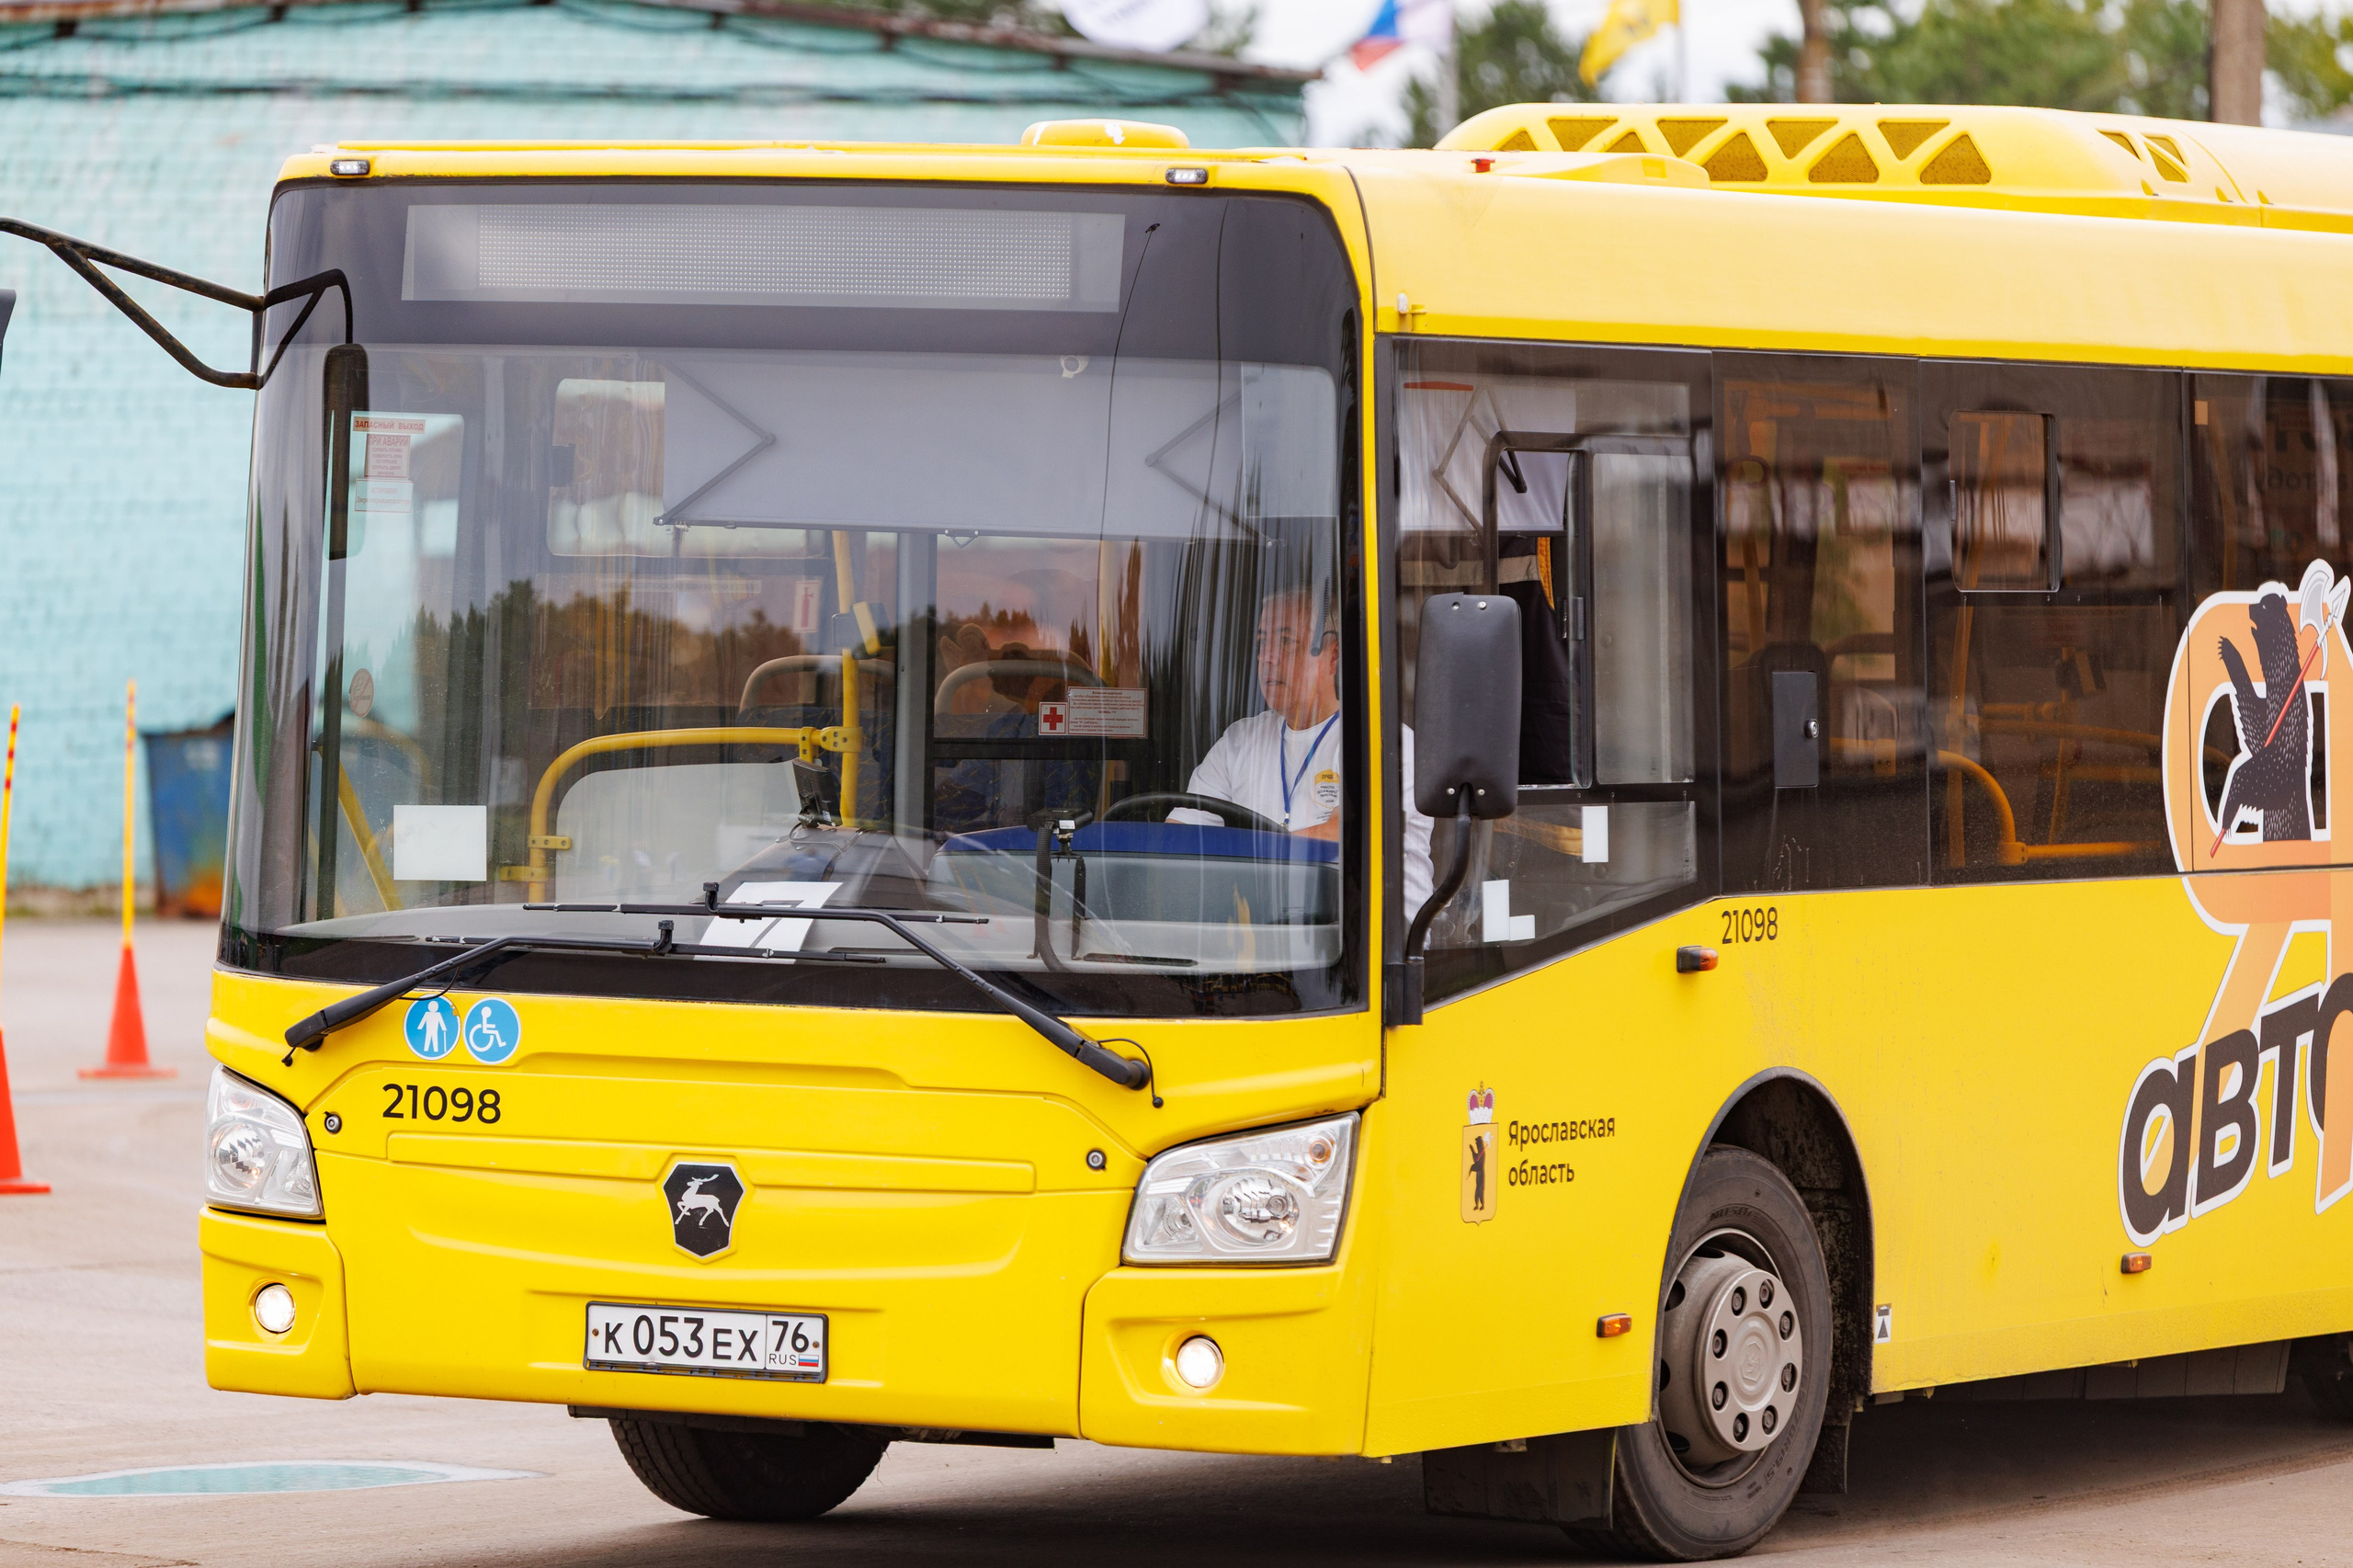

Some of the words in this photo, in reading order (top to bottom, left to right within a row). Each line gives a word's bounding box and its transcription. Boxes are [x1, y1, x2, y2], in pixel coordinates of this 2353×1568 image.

[354, 419, 394, 430] ЗАПАСНЫЙ
[398, 422, 424, 431] ВЫХОД
[369, 436, 381, 446] ПРИ
[382, 437, 408, 447] АВАРИИ
[1722, 906, 1779, 945] 21098
[382, 1083, 501, 1124] 21098
[1508, 1117, 1616, 1152] Ярославская
[1508, 1158, 1575, 1187] область
[772, 1320, 810, 1353] 76
[768, 1353, 797, 1366] RUS
